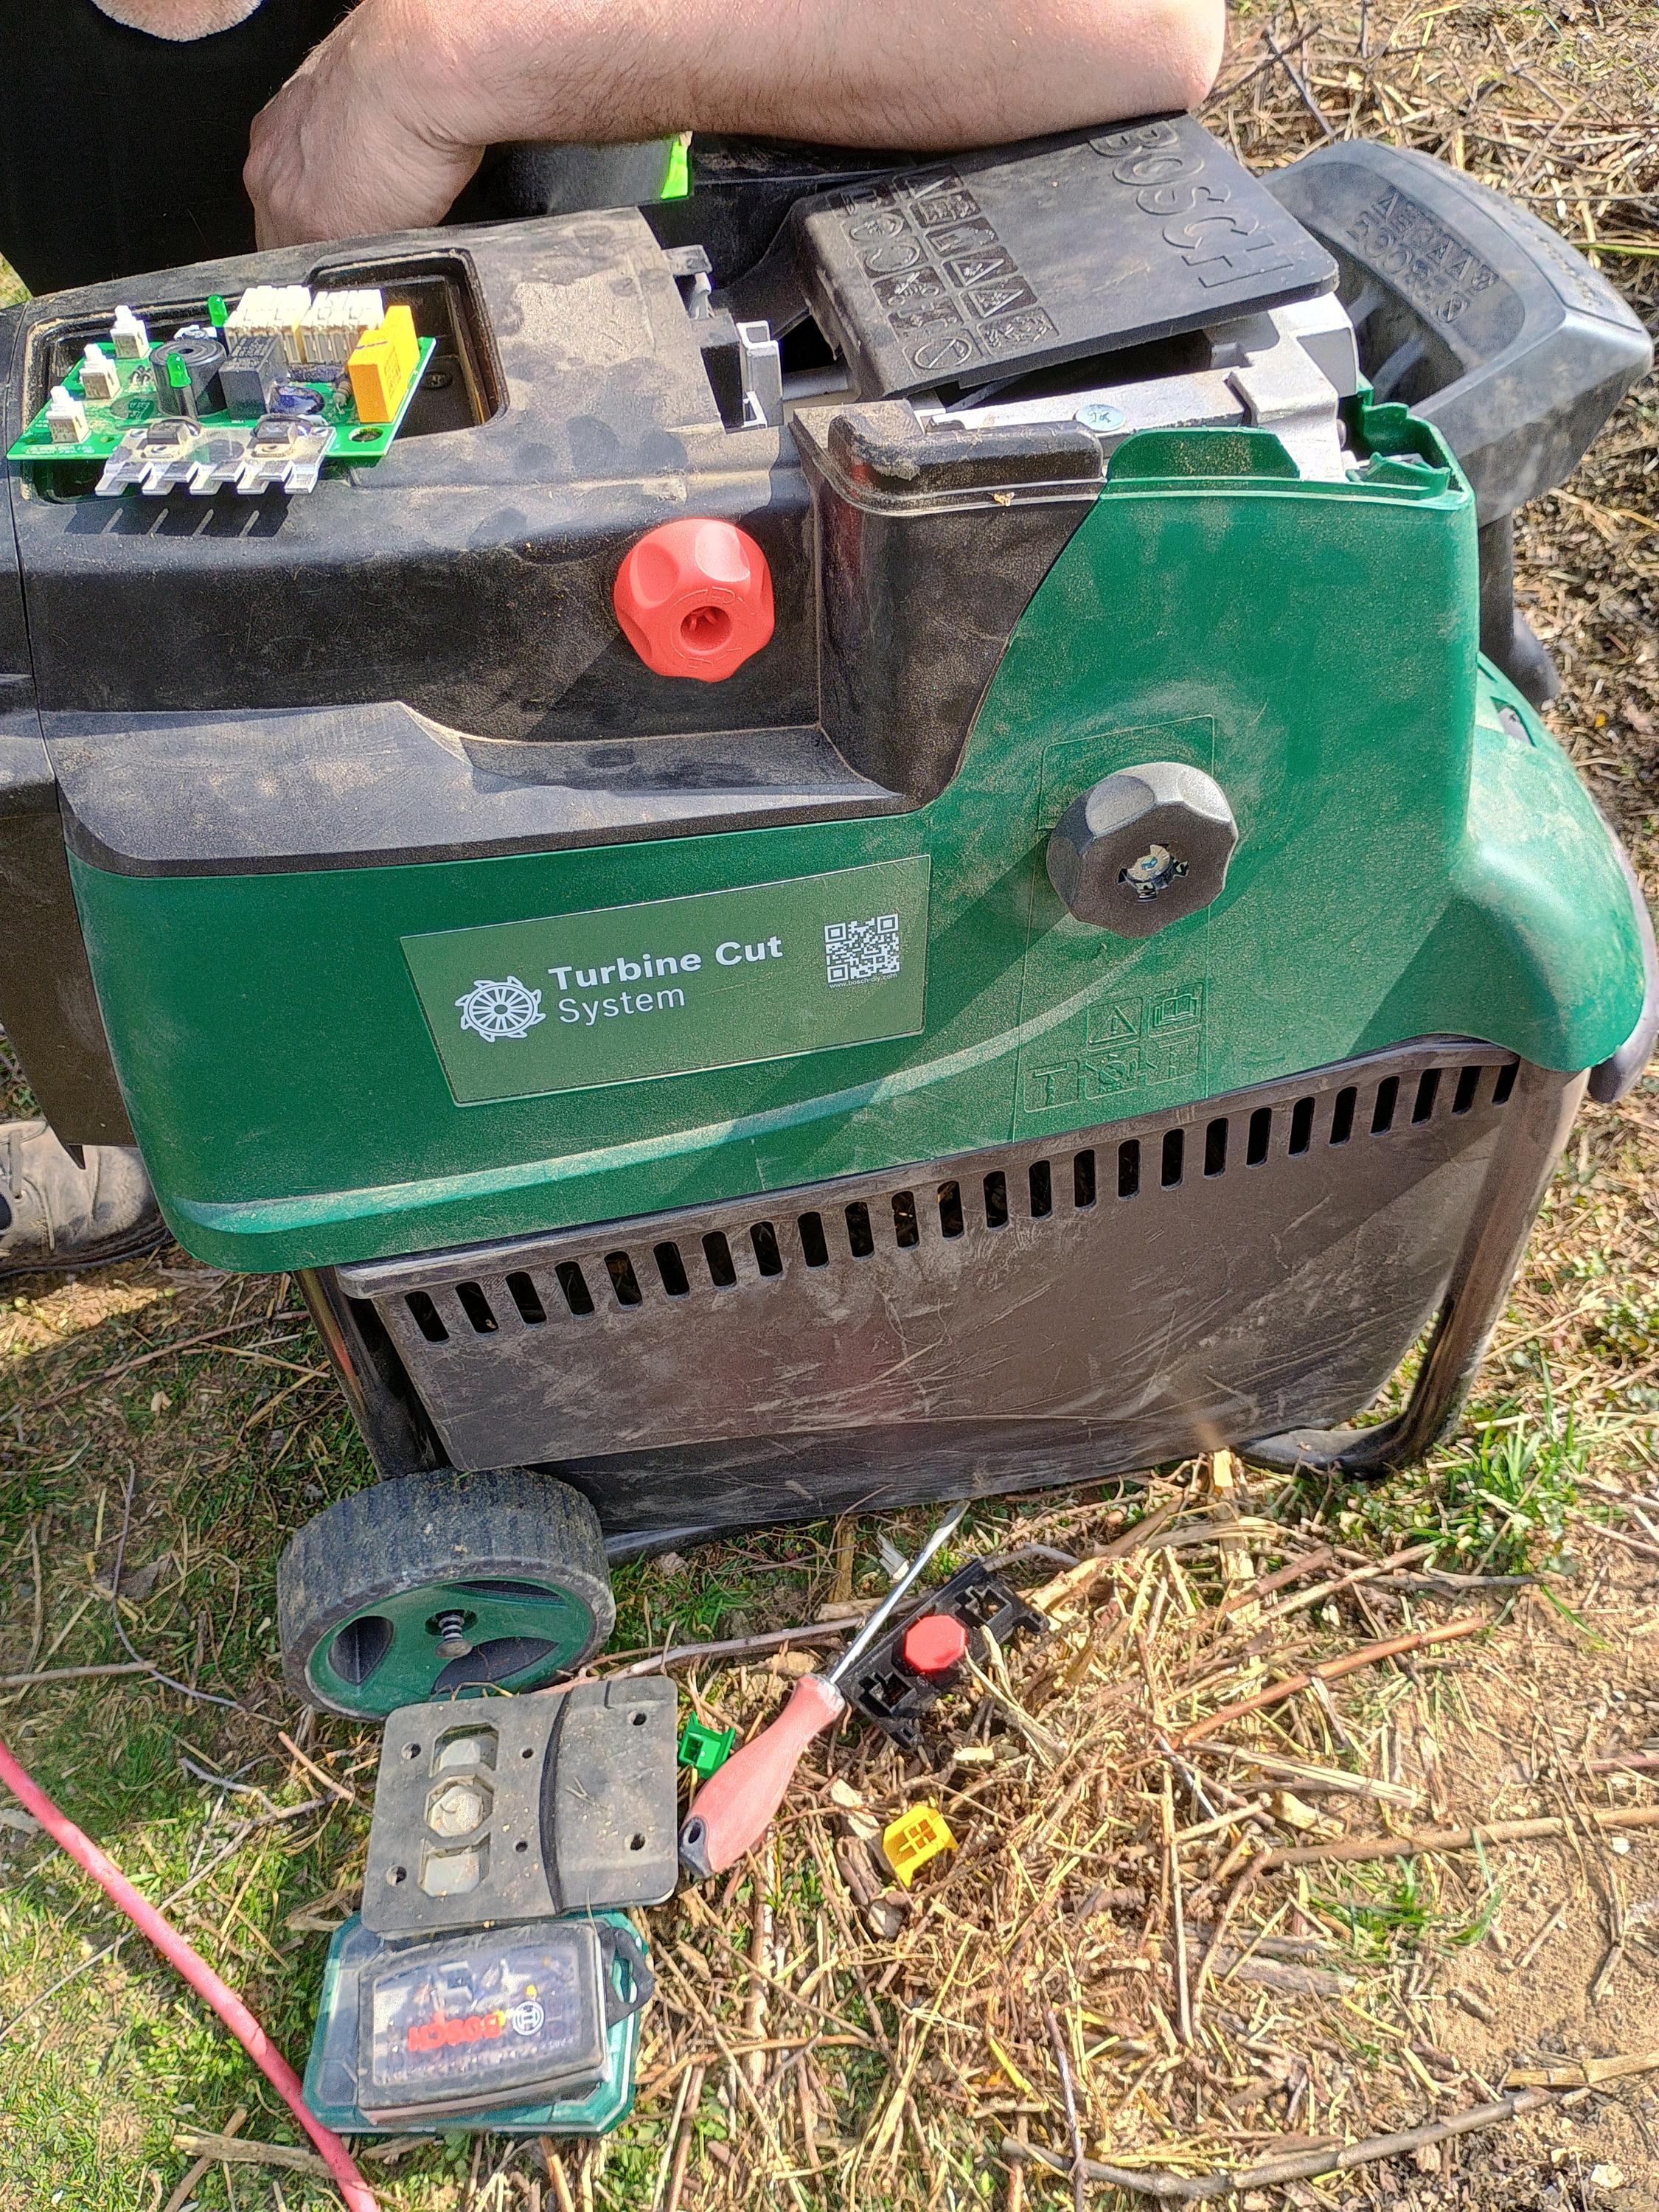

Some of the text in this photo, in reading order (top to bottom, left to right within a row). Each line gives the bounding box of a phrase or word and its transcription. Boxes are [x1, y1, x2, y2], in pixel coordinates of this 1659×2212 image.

[548, 935, 784, 991] Turbine Cut
[829, 973, 897, 988] www.bosch-diy.com
[558, 987, 686, 1026] System
[408, 2014, 503, 2053] BOSCH
